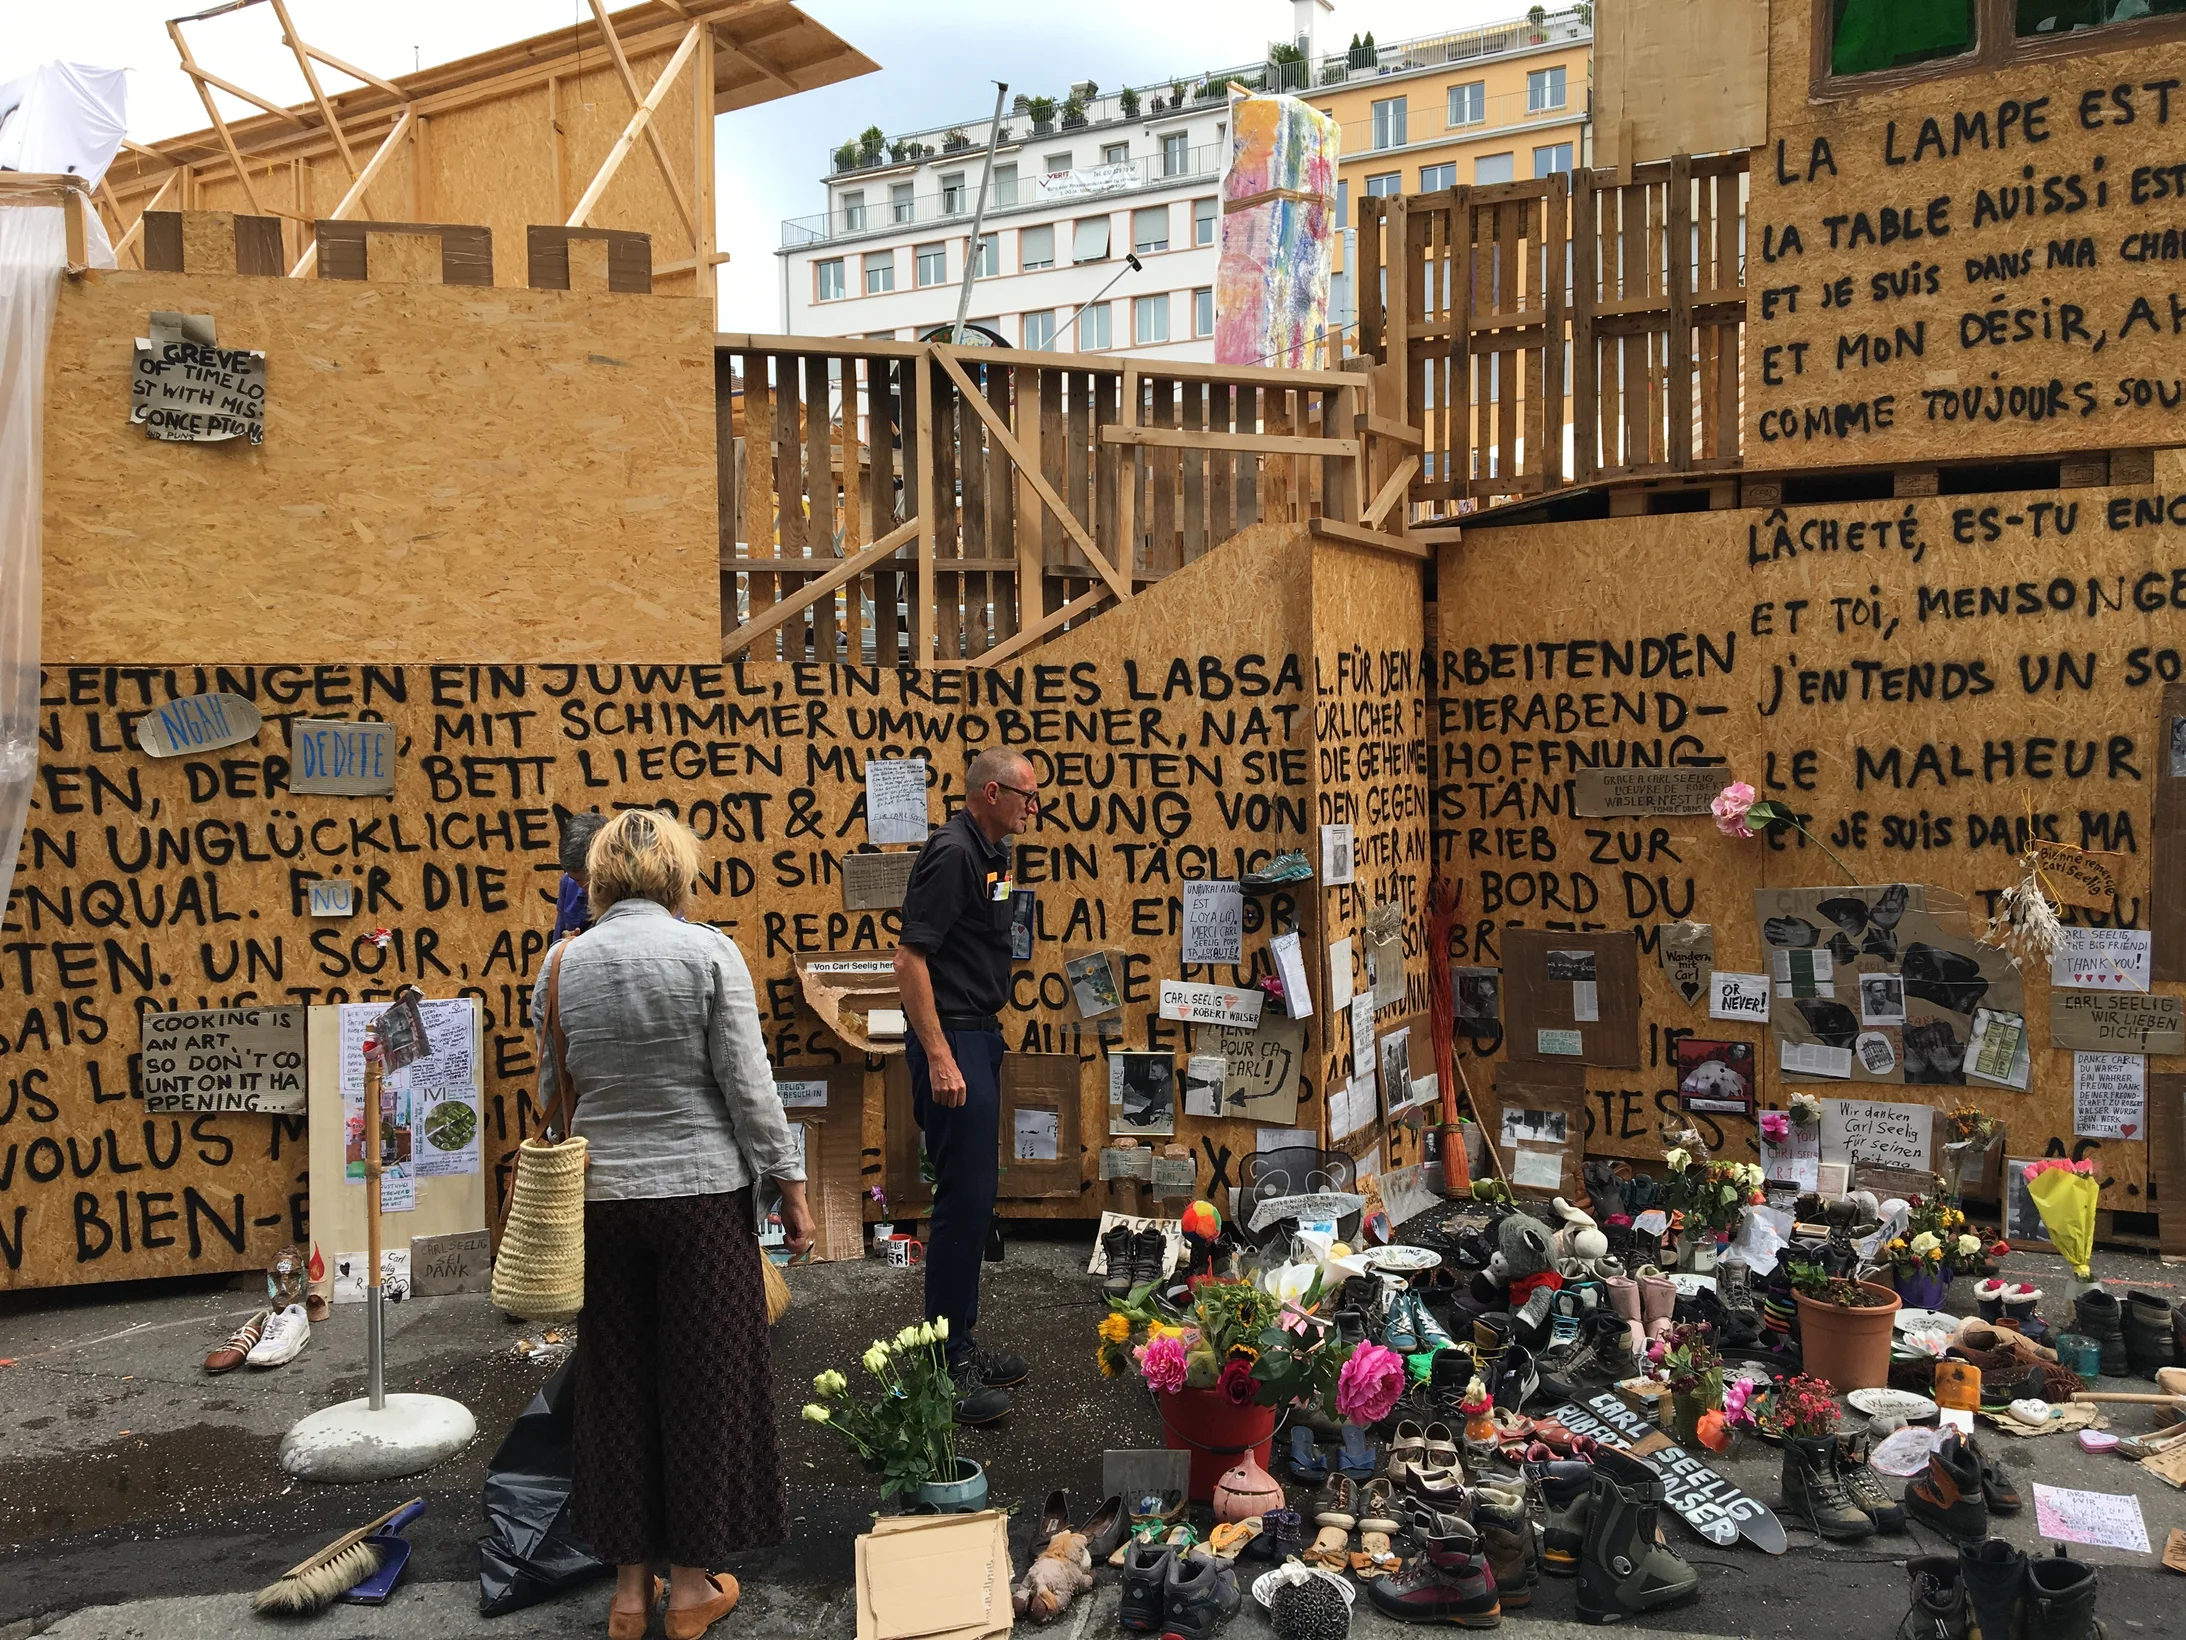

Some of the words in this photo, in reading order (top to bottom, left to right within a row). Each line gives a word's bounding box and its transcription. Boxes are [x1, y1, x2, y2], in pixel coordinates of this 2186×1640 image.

[1777, 138, 1838, 185] LA
[1885, 97, 2050, 166] LAMPE
[2080, 79, 2180, 130] EST
[1047, 170, 1069, 180] VERIT
[1763, 225, 1803, 263] LA
[1823, 197, 1952, 250] TABLE
[2130, 163, 2186, 205] EST
[1762, 285, 1801, 321] ET
[1821, 277, 1854, 309] JE
[1965, 249, 2032, 284] DANS
[2047, 238, 2097, 269] MA
[1763, 342, 1810, 386] ET
[1836, 320, 1926, 371] MON
[139, 358, 175, 376] OF
[184, 364, 234, 389] TIME
[236, 378, 264, 400] LO
[133, 379, 157, 397] ST
[163, 382, 215, 405] WITH
[1759, 394, 1896, 442] COMME
[2114, 377, 2183, 409] SOU
[1749, 503, 1927, 566] LÂCHETÉ,
[1952, 501, 2079, 544] ES-TU
[1751, 598, 1808, 637] ET
[1918, 568, 2186, 622] MENSONGE
[1338, 644, 1373, 694] FÜR
[1380, 652, 1412, 692] DEN
[2018, 651, 2096, 694] UN
[2125, 646, 2182, 687] SO
[431, 666, 526, 709] EIN
[539, 664, 782, 700] JUWEL,
[792, 663, 879, 701] EIN
[898, 661, 1101, 708] REINES
[1124, 654, 1302, 701] LABSA
[1314, 697, 1403, 742] ÜRLICHER
[1439, 690, 1729, 737] EIERABEND-
[434, 710, 537, 752] MIT
[561, 700, 836, 741] SCHIMMER
[846, 706, 1188, 749] UMWOBENER,
[1201, 703, 1300, 746] NAT
[184, 755, 291, 803] DER
[422, 756, 557, 802] BETT
[578, 740, 782, 788] LIEGEN
[1241, 749, 1307, 786] SIE
[1319, 745, 1350, 785] DIE
[1357, 738, 1427, 780] GEHEIME
[1765, 749, 1818, 791] LE
[1855, 735, 2142, 791] MALHEUR
[1603, 775, 1635, 785] GRACE
[1648, 775, 1671, 783] CARL
[1673, 774, 1714, 783] SEELIG
[1664, 784, 1679, 794] DE
[1686, 781, 1727, 793] ROBERT
[785, 788, 824, 840] &
[1216, 791, 1307, 835] VON
[1319, 791, 1360, 825] DEN
[1366, 786, 1427, 821] GEGEN
[1765, 812, 1811, 852] ET
[1830, 810, 1868, 850] JE
[1968, 811, 2059, 856] DANS
[2079, 809, 2137, 855] MA
[1405, 827, 1425, 862] AN
[1440, 827, 1556, 862] TRIEB
[1584, 828, 1681, 864] ZUR
[2040, 848, 2083, 864] Bienne
[424, 863, 507, 912] DIE
[1375, 868, 1416, 916] HÂTE
[1482, 871, 1599, 914] BORD
[1623, 871, 1695, 920] DU
[313, 887, 349, 913] NU
[1193, 899, 1209, 909] EST
[1192, 926, 1216, 940] MERCI
[1220, 926, 1237, 937] CARL
[1194, 939, 1219, 947] SEELIG
[2092, 930, 2130, 941] SEELIG,
[201, 936, 283, 983] UN
[310, 926, 469, 980] SOIR,
[1187, 948, 1198, 956] TA
[1666, 950, 1711, 963] Wandern
[2089, 941, 2105, 950] BIG
[2108, 941, 2148, 951] FRIEND!
[832, 962, 849, 970] Carl
[852, 962, 878, 971] Seelig
[1679, 960, 1698, 968] mit
[2064, 958, 2108, 972] THANK
[2114, 953, 2142, 970] YOU!
[1674, 968, 1699, 981] Carl
[1164, 991, 1188, 1005] CARL
[1192, 993, 1222, 1007] SEELIG
[1722, 983, 1740, 997] OR
[1721, 991, 1766, 1014] NEVER!
[2065, 996, 2103, 1009] CARL
[2108, 996, 2175, 1012] SEELIG
[152, 1011, 260, 1033] COOKING
[272, 1012, 292, 1029] IS
[1193, 1006, 1227, 1020] ROBERT
[1229, 1008, 1260, 1023] WALSER
[2091, 1011, 2119, 1024] WIR
[2124, 1013, 2178, 1031] LIEBEN
[146, 1037, 178, 1051] AN
[1221, 1039, 1254, 1056] POUR
[1261, 1042, 1281, 1060] ÇA
[147, 1058, 175, 1074] SO
[189, 1049, 267, 1072] DON'T
[272, 1051, 300, 1069] CO
[2078, 1055, 2109, 1064] DANKE
[2111, 1055, 2140, 1067] CARL,
[2080, 1065, 2091, 1073] DU
[146, 1076, 193, 1095] UNT
[197, 1073, 225, 1092] ON
[239, 1072, 262, 1091] IT
[270, 1072, 300, 1090] HA
[2081, 1074, 2095, 1082] EIN
[2099, 1074, 2133, 1082] WAHRER
[2117, 1083, 2141, 1091] DANK
[1840, 1102, 1859, 1116] Wir
[1865, 1106, 1910, 1122] danken
[2078, 1106, 2110, 1114] WALSER
[2079, 1115, 2097, 1123] SEIN
[1794, 1130, 1816, 1142] YOU
[1845, 1119, 1872, 1134] Carl
[1876, 1122, 1918, 1144] Seelig
[2077, 1123, 2118, 1132] ERHALTEN!
[1767, 1149, 1793, 1159] CARL
[1843, 1134, 1867, 1150] für
[1870, 1140, 1922, 1157] seinen
[388, 1252, 404, 1263] Carl
[422, 1243, 448, 1256] CARL
[449, 1238, 488, 1251] SEELIG
[437, 1254, 461, 1265] SEI
[425, 1265, 470, 1278] DANK
[1546, 1404, 1632, 1450] ROBERT
[1589, 1393, 1649, 1439] CARL
[1655, 1447, 1765, 1521] SEELIG
